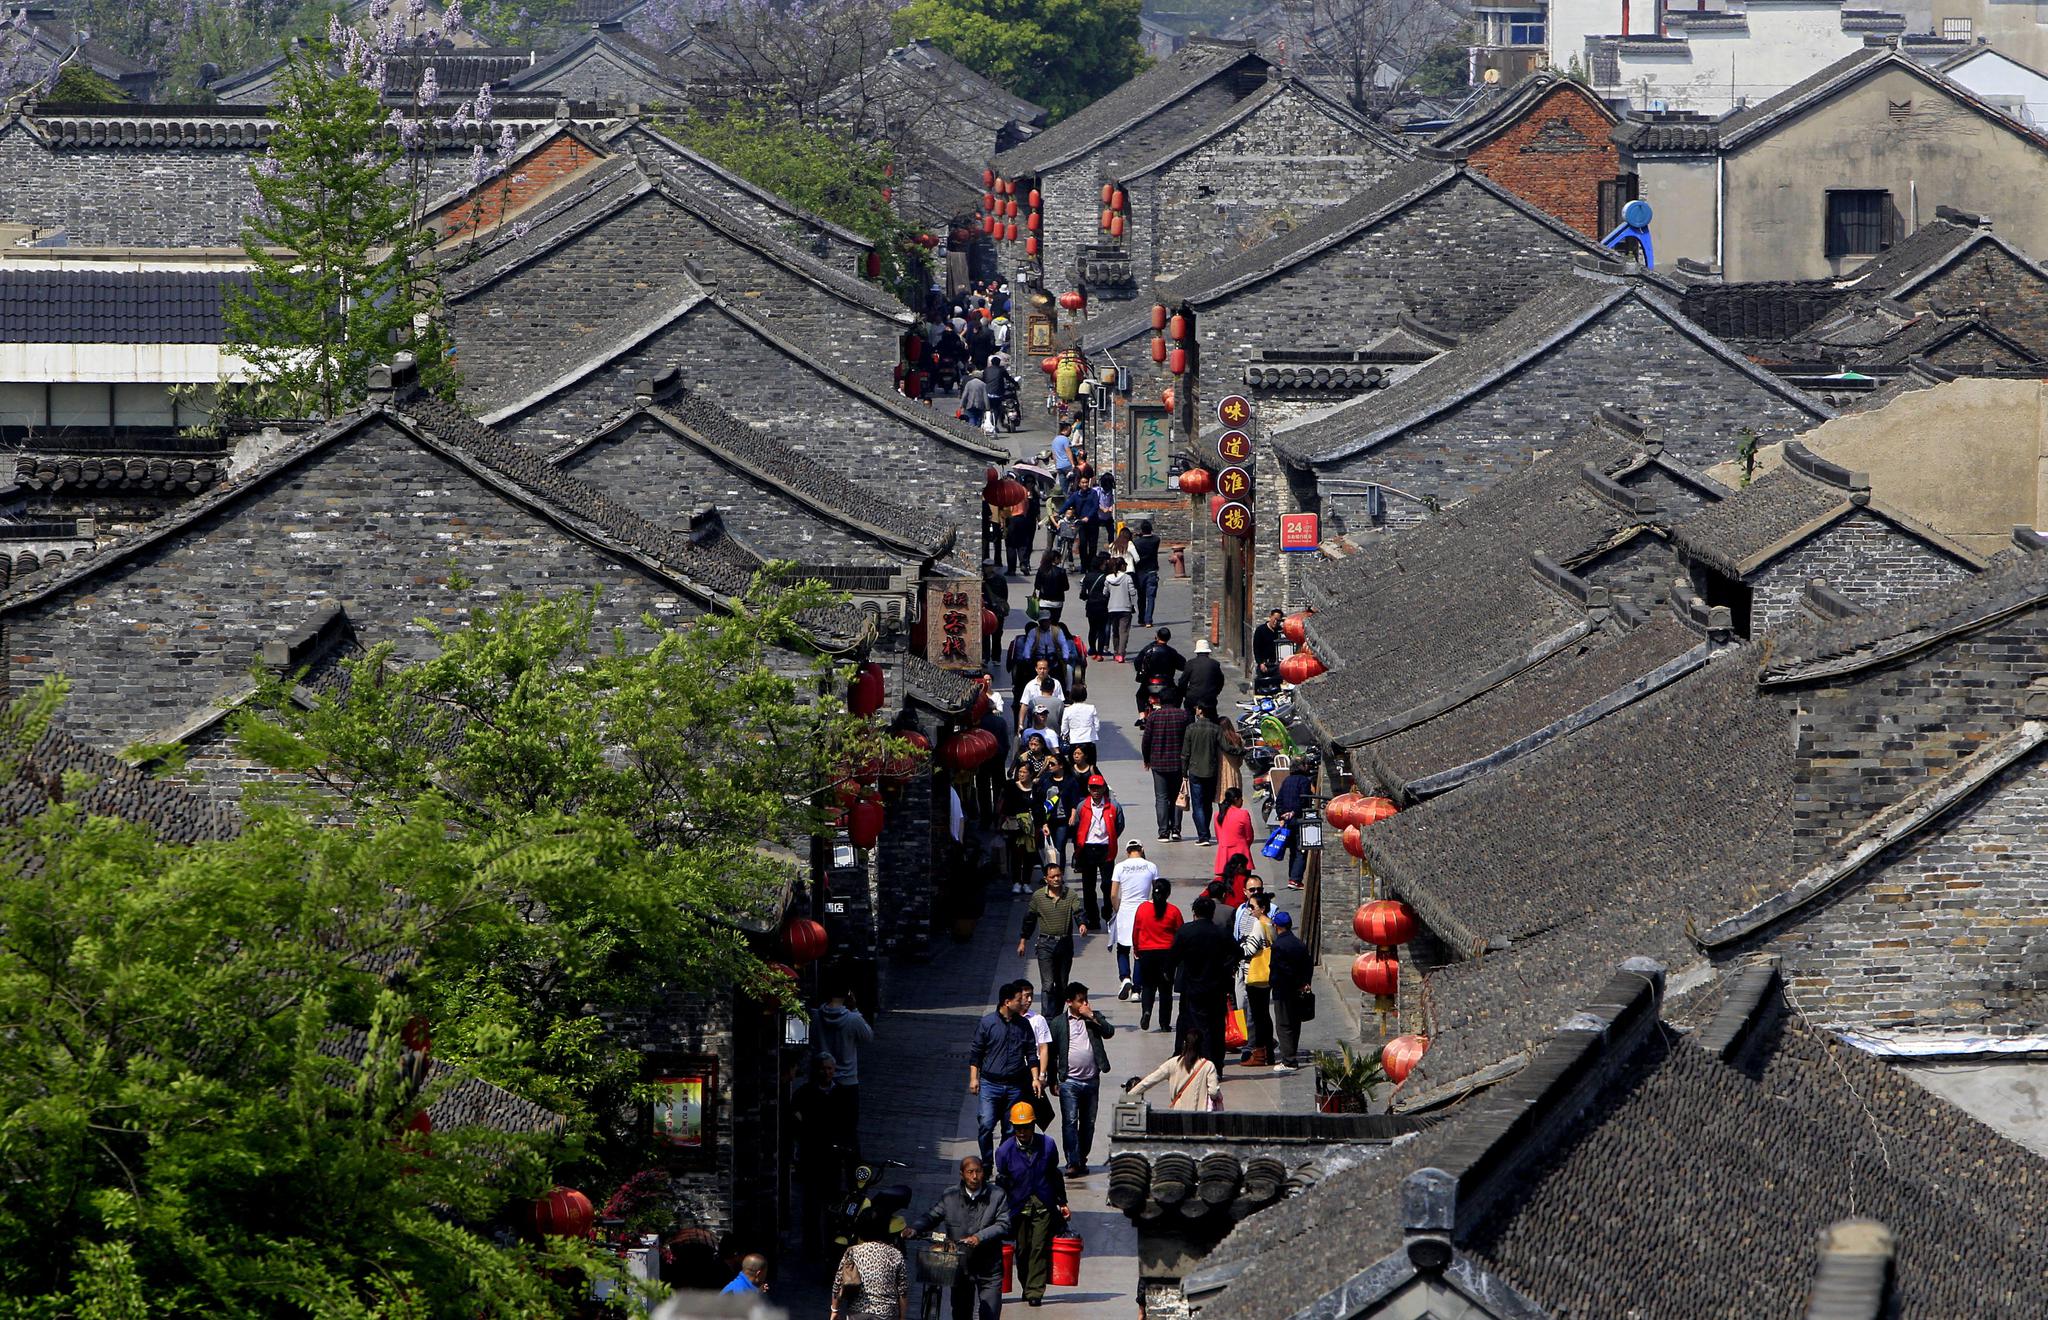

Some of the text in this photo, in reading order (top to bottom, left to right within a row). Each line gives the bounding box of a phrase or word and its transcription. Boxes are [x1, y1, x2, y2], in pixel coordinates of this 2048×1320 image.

[1224, 401, 1246, 530] 味道淮揚
[1288, 522, 1303, 533] 24
